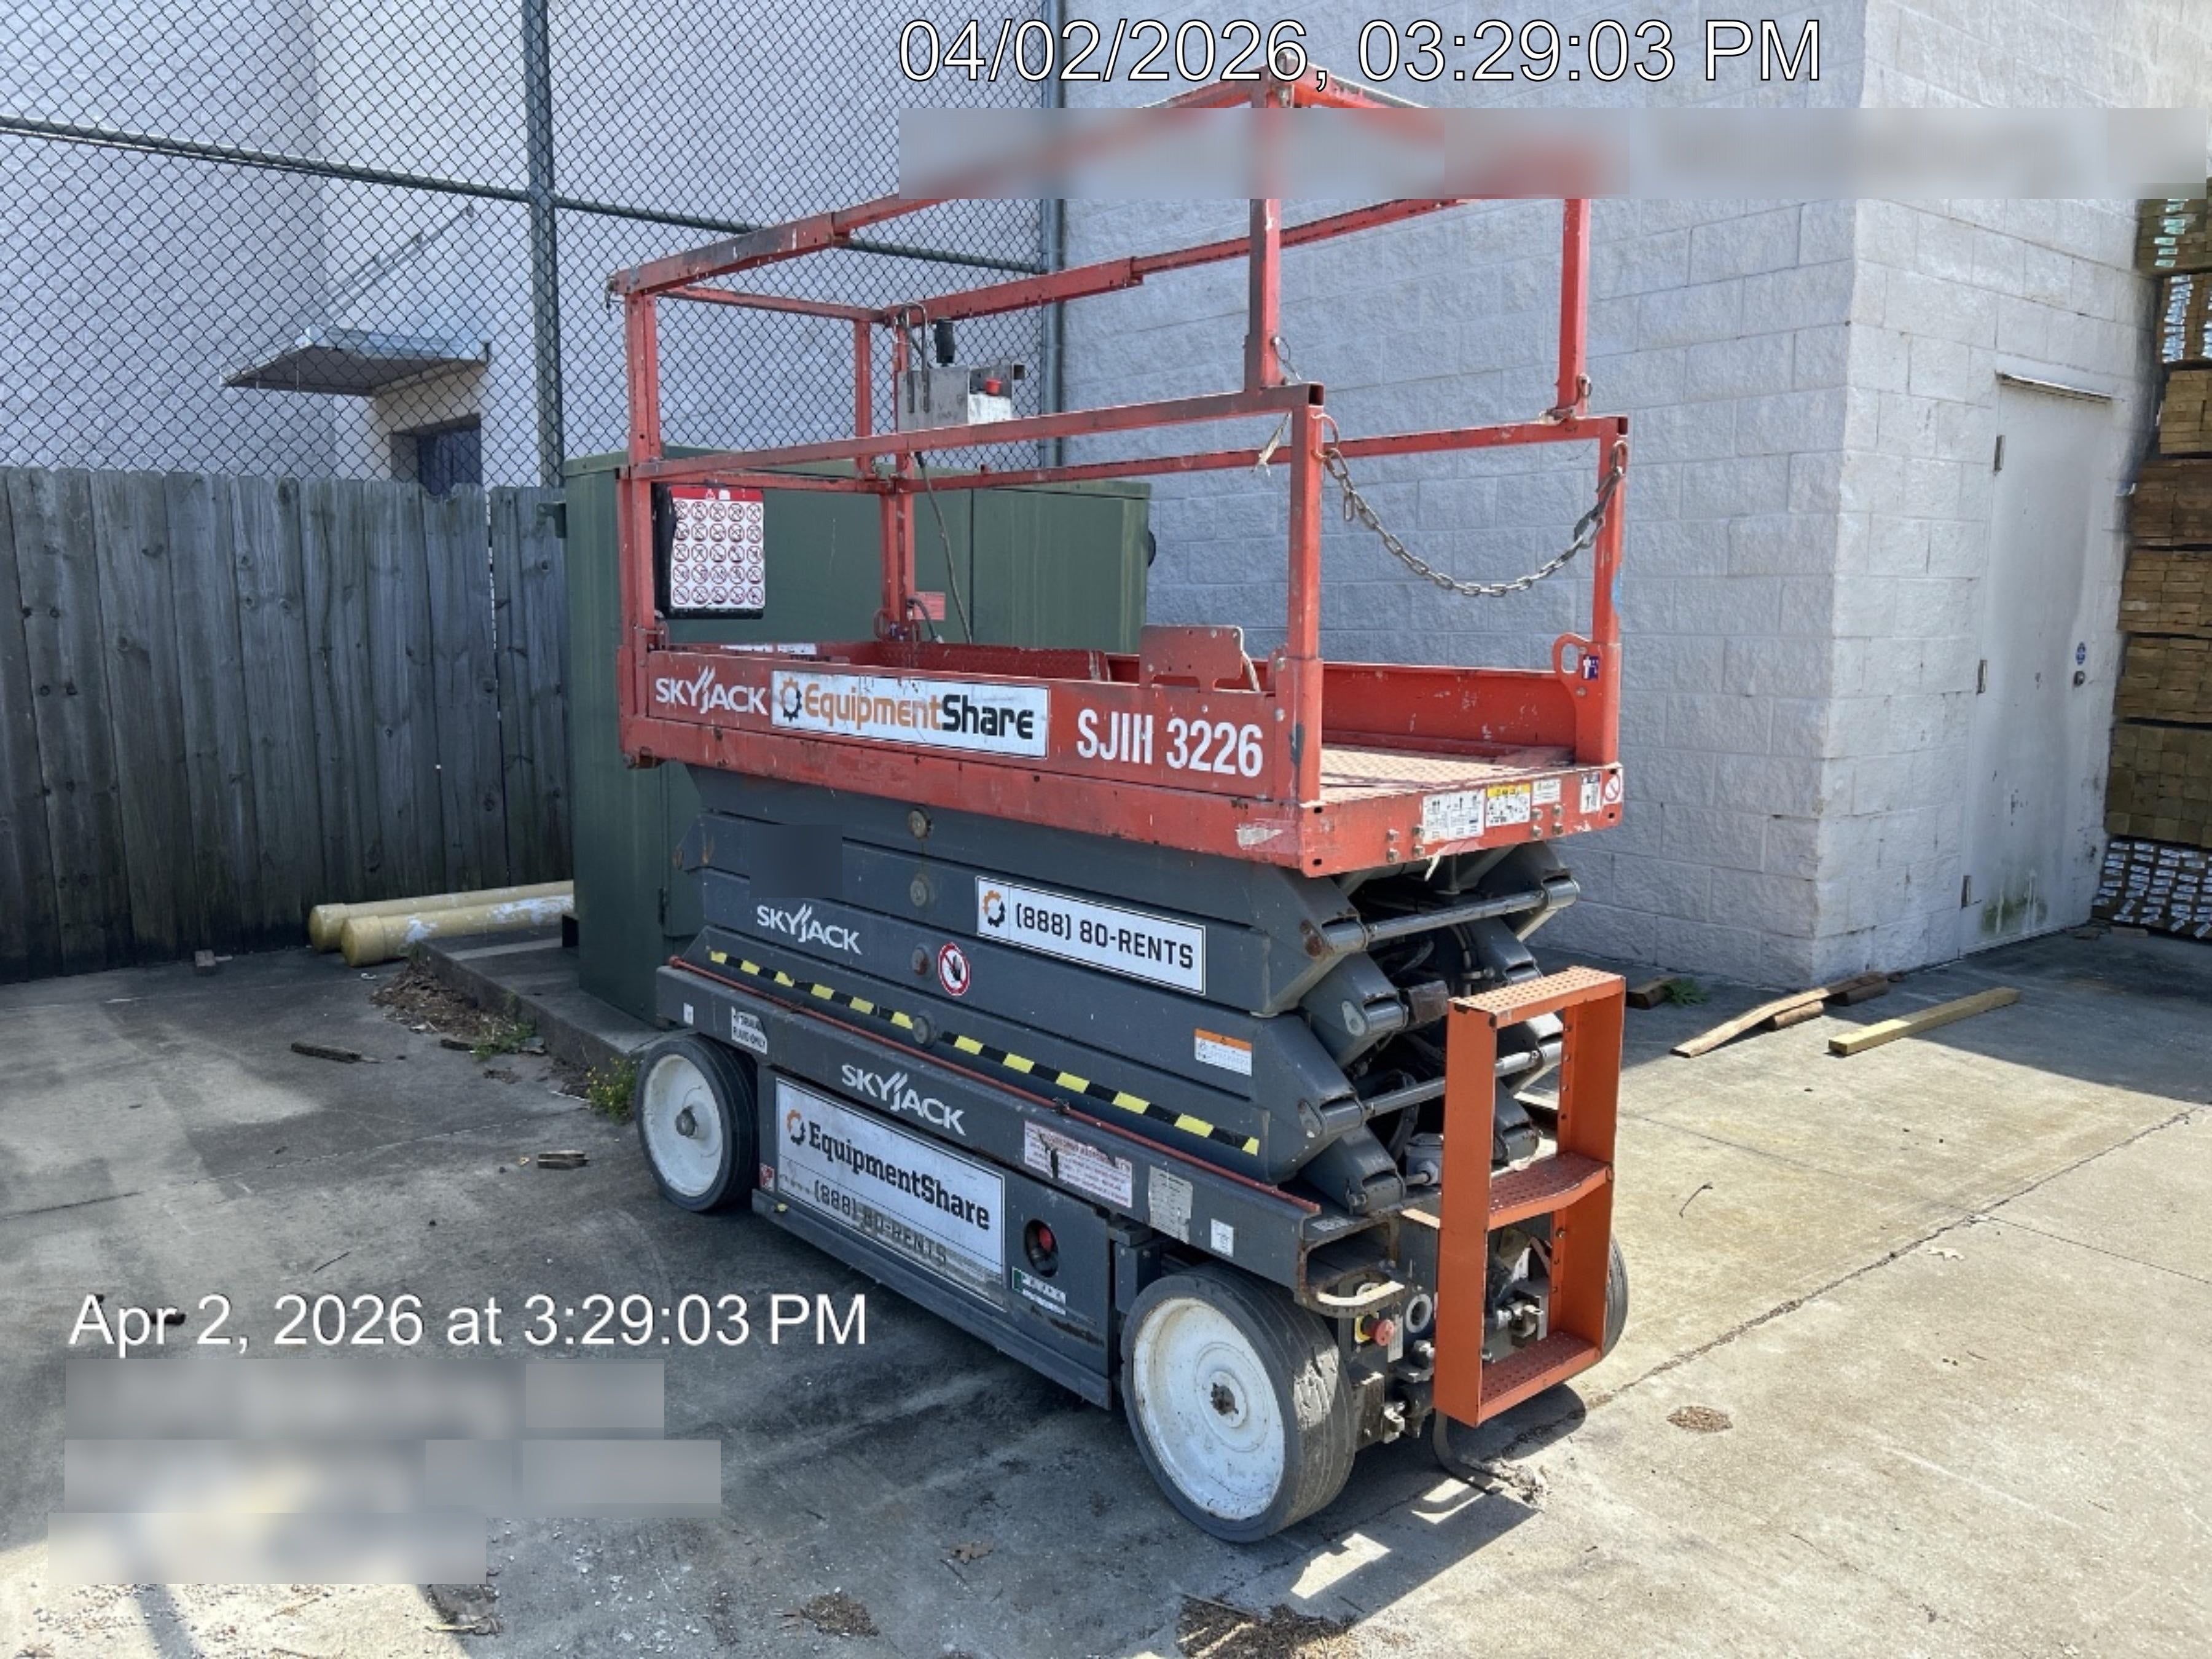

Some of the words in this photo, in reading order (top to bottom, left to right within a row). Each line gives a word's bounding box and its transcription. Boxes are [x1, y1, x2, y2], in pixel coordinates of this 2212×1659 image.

[655, 664, 769, 716] SKYJACK
[804, 679, 1034, 739] EquipmentShare
[1166, 716, 1264, 777] 3226
[756, 903, 863, 955] SKYJACK
[1015, 902, 1072, 941] (888)
[1080, 919, 1194, 970] 80-RENTS
[841, 1064, 967, 1137] SKYJACK
[808, 1120, 990, 1230] EquipmentShare
[814, 1179, 858, 1222] (888)
